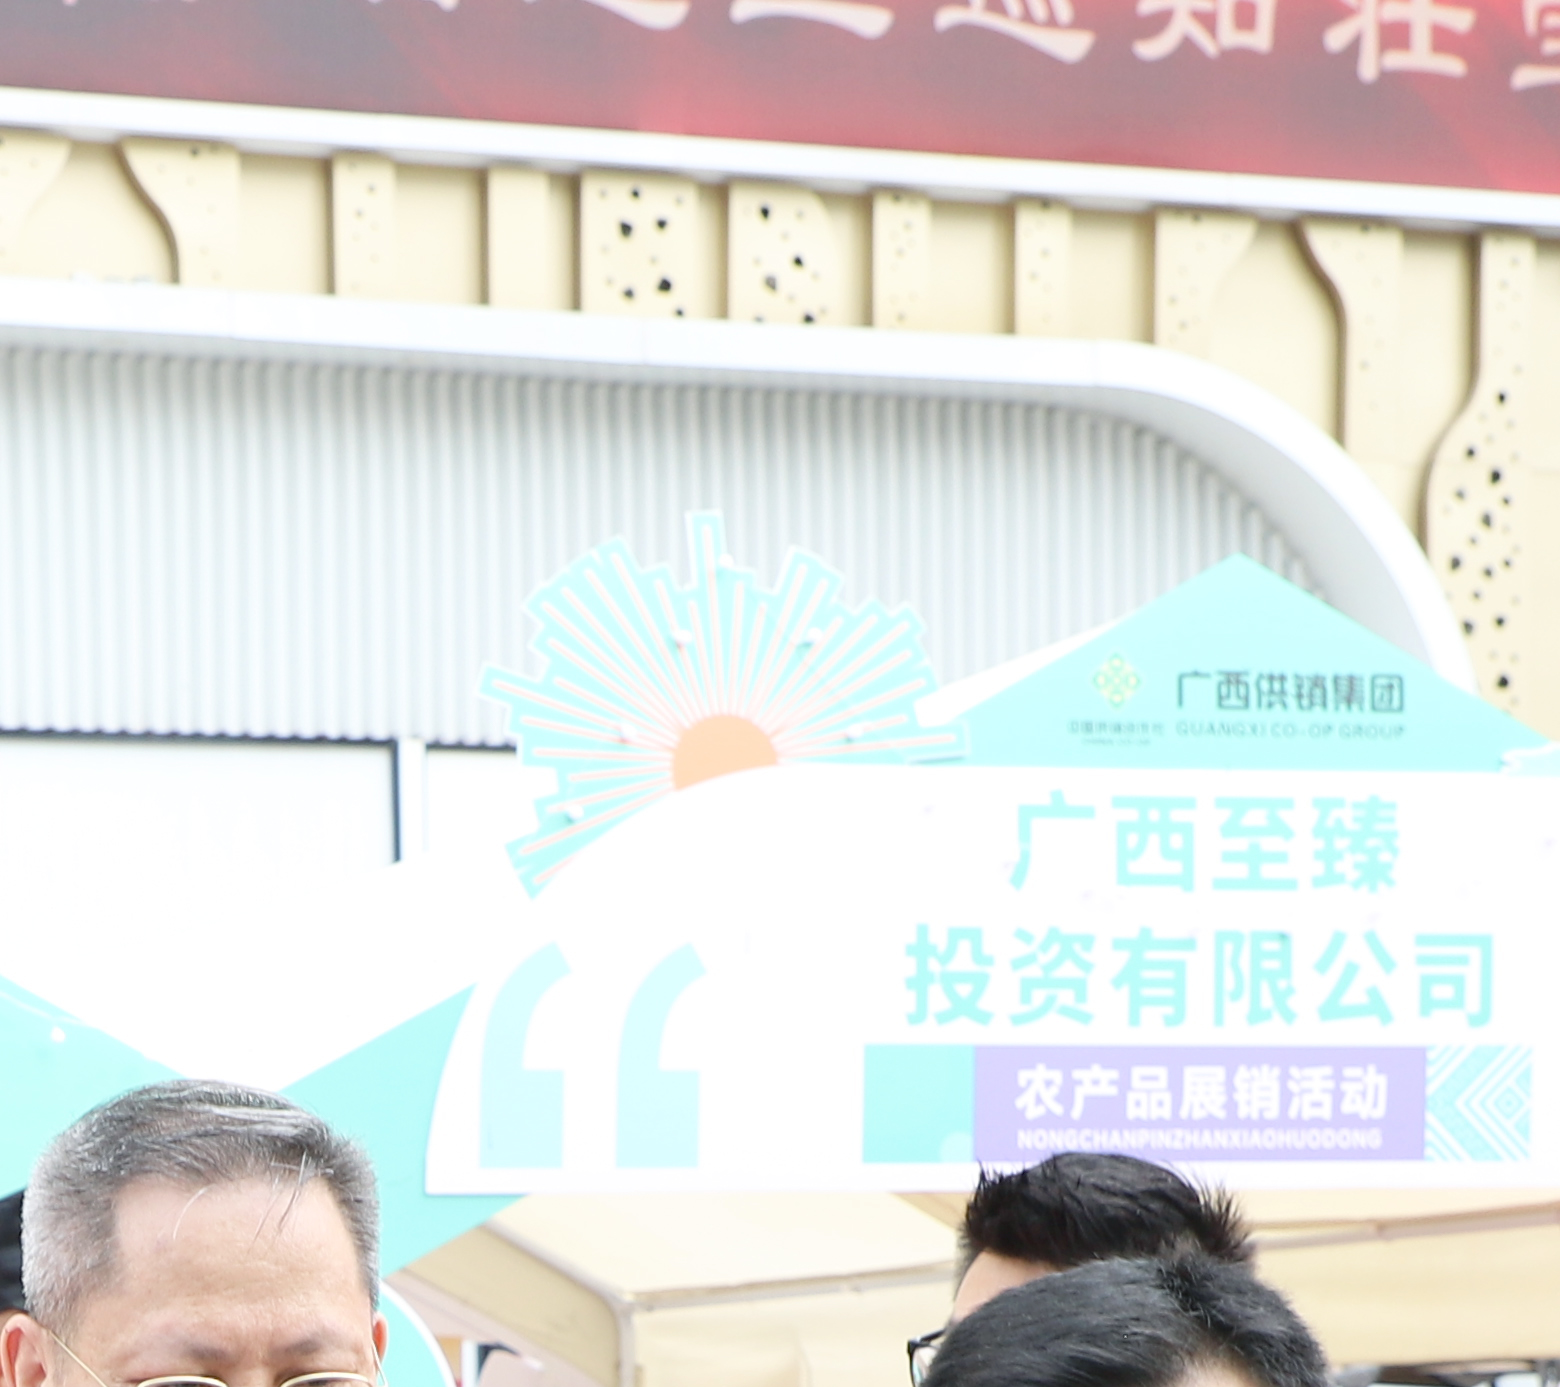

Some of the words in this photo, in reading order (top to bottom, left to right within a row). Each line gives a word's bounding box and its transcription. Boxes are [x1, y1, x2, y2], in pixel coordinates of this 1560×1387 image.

[1175, 668, 1406, 714] 广西供销集团
[1176, 721, 1266, 739] GUANGXI
[1339, 723, 1406, 741] GROUP
[1008, 788, 1401, 893] 广西至臻
[903, 923, 1497, 1030] 投资有限公司
[1014, 1061, 1390, 1122] 农产品展销活动
